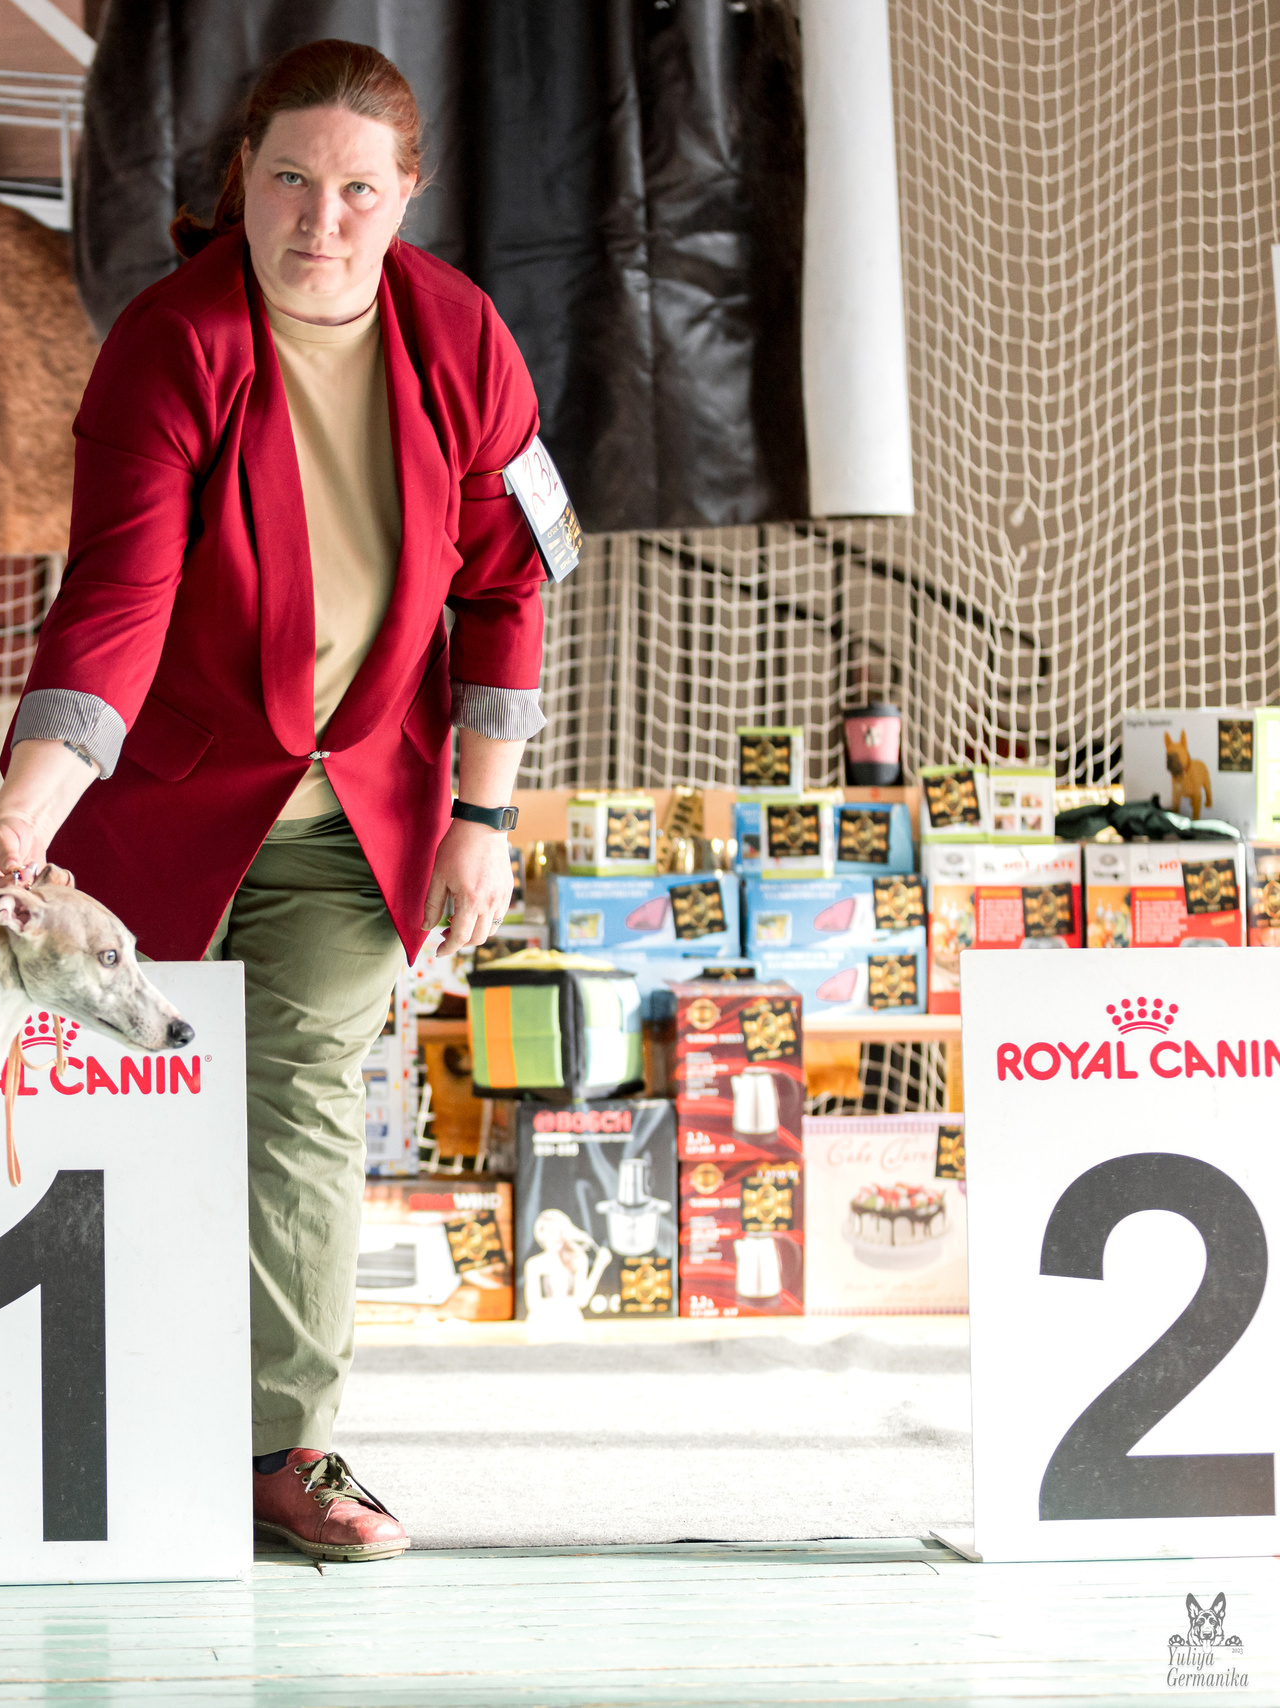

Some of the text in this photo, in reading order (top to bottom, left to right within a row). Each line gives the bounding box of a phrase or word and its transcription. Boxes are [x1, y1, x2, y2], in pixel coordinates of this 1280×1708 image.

[49, 1055, 202, 1096] CANIN
[997, 1041, 1139, 1081] ROYAL
[555, 1110, 632, 1133] BOSCH
[1038, 1152, 1276, 1521] 2
